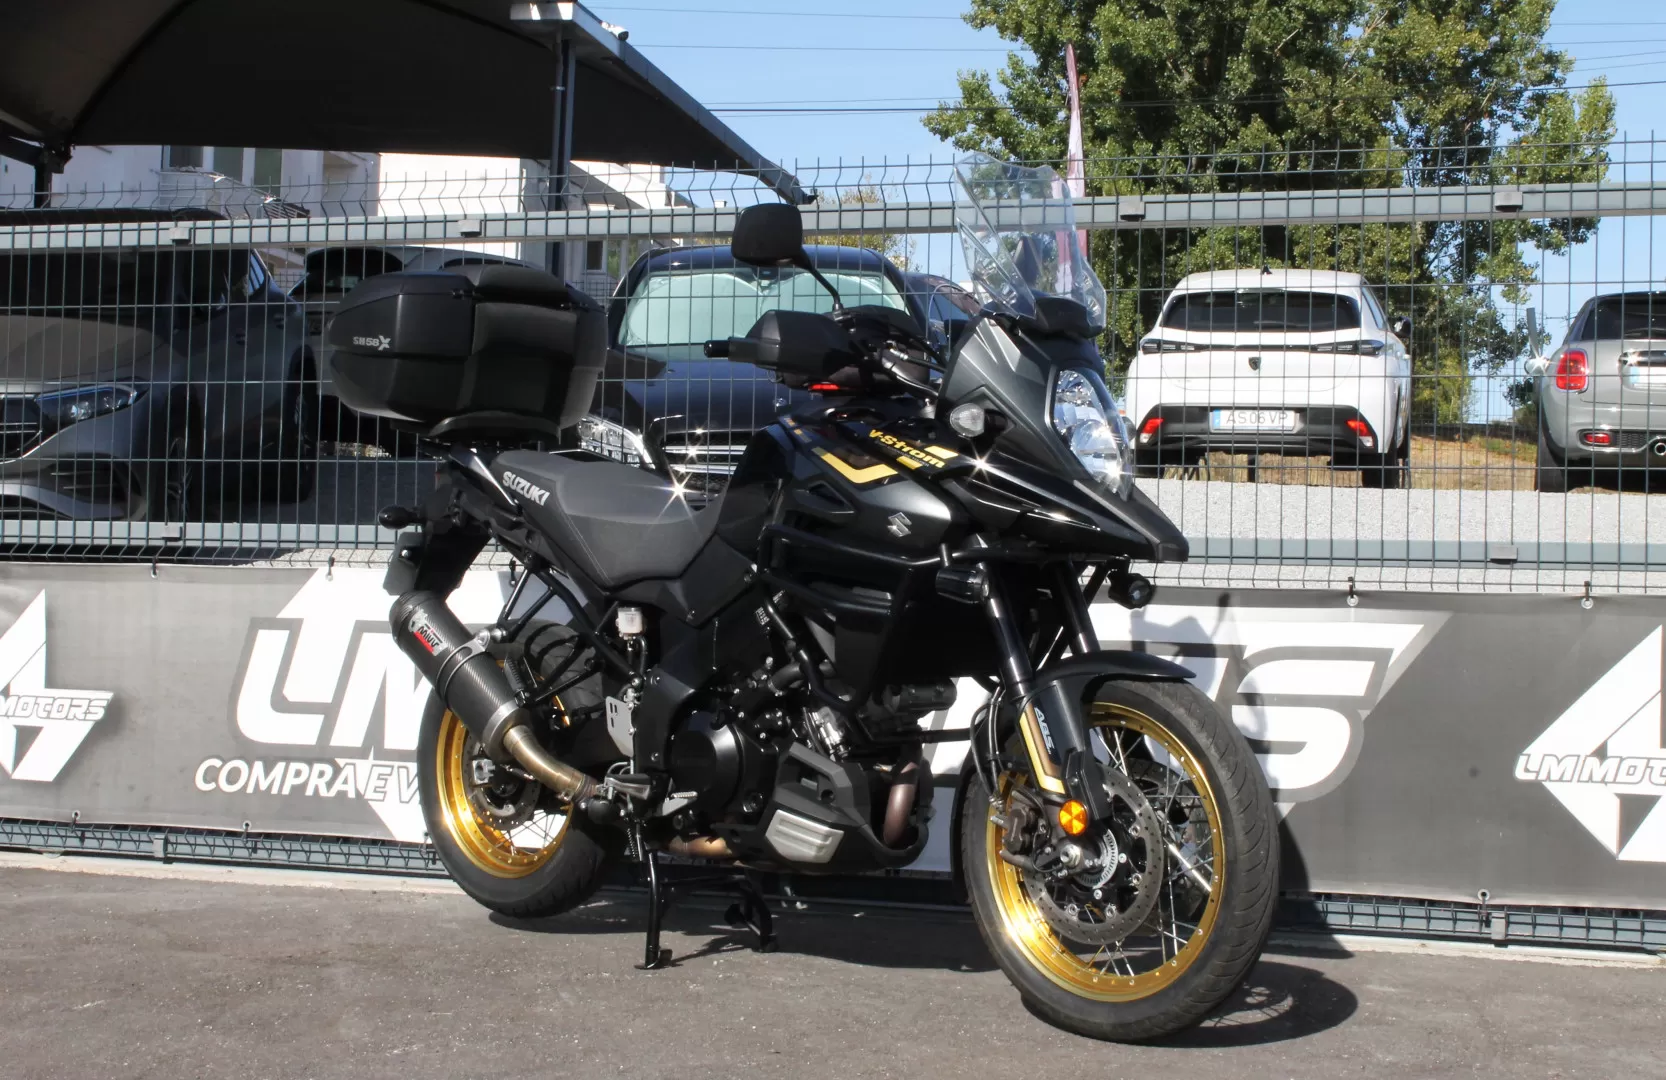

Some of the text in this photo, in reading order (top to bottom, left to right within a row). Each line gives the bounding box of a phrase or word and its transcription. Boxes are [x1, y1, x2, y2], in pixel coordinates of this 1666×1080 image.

[869, 429, 946, 468] V-Strom
[502, 471, 551, 506] SUZUKI
[1033, 706, 1056, 755] ABS
[194, 757, 358, 799] COMPRA
